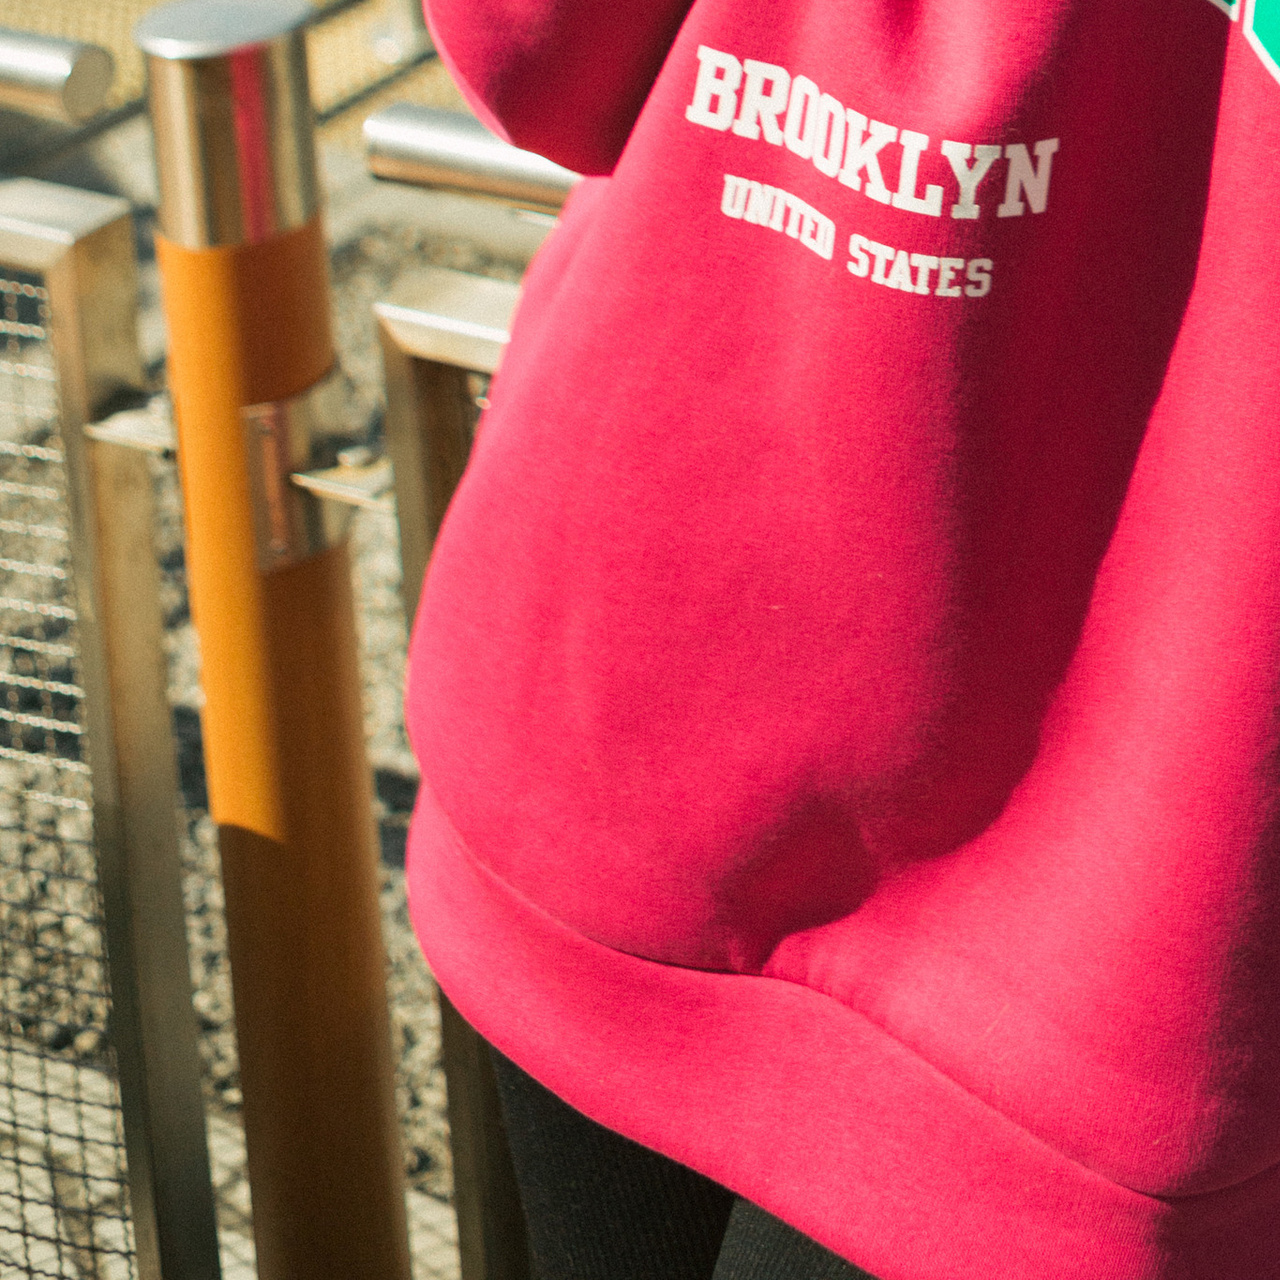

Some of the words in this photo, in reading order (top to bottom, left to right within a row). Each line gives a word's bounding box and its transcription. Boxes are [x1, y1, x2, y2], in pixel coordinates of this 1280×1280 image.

[685, 44, 1060, 220] BROOKLYN
[720, 173, 836, 260] UNITED
[847, 233, 994, 298] STATES
